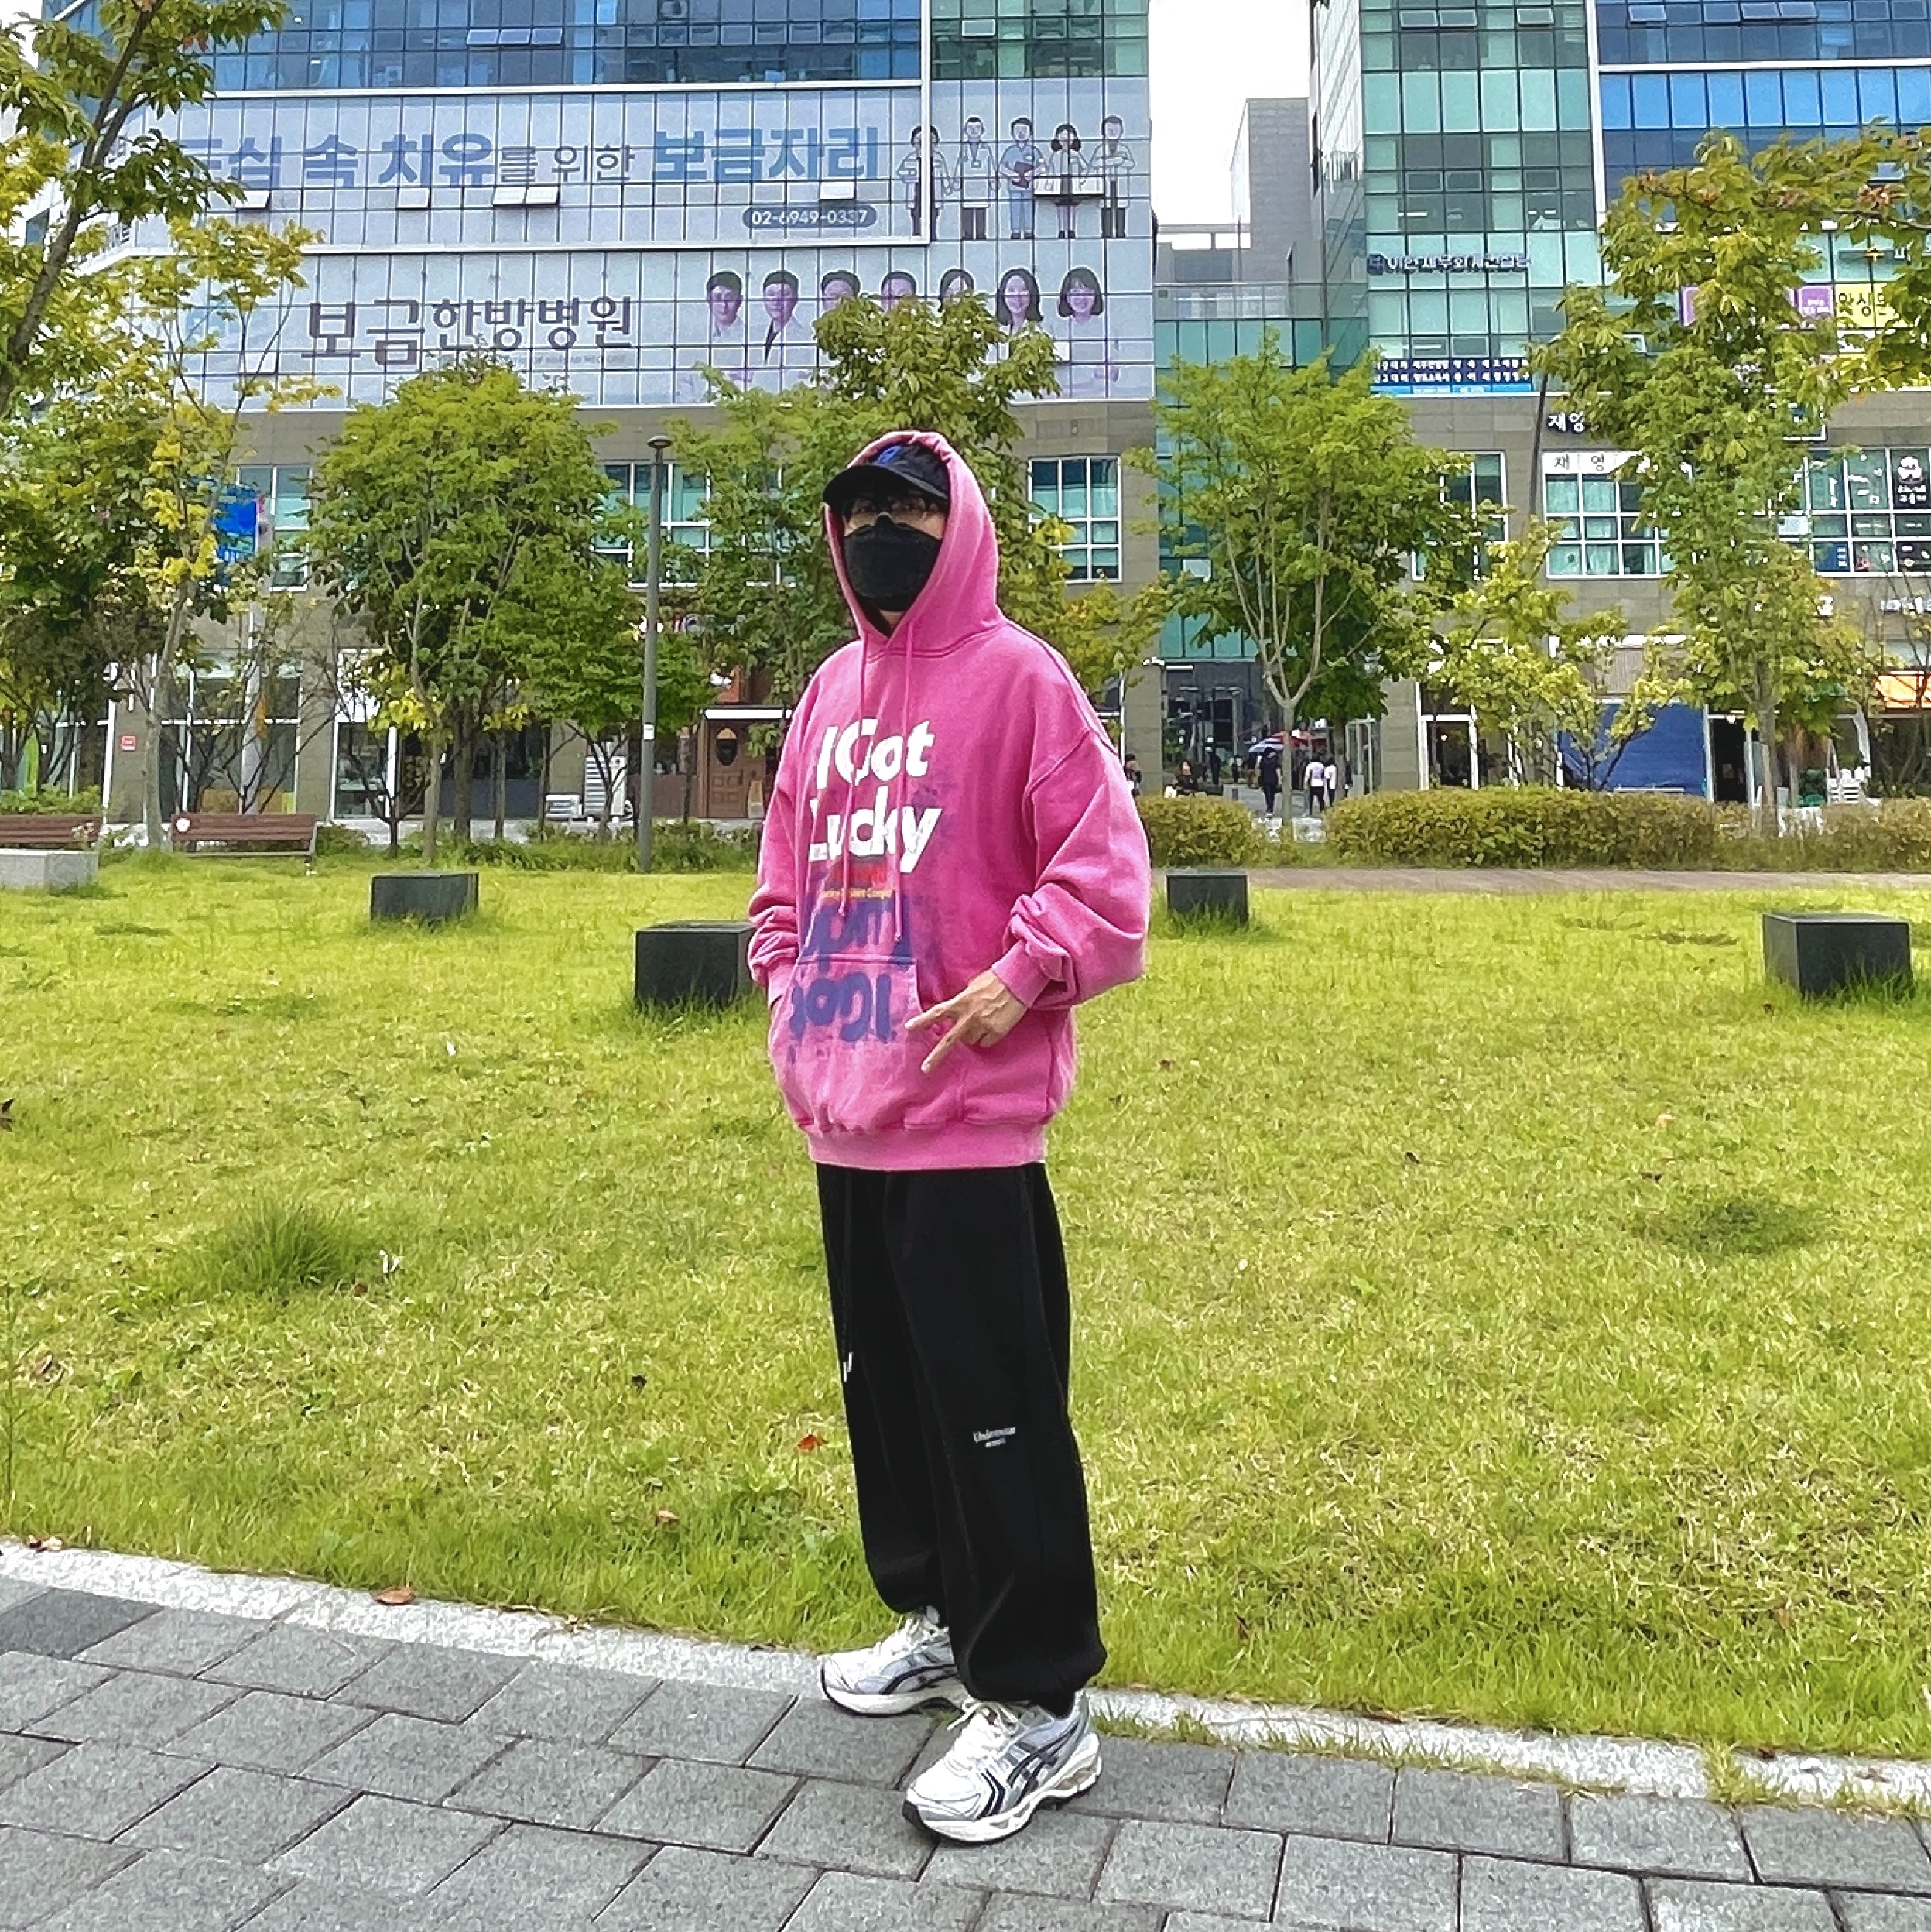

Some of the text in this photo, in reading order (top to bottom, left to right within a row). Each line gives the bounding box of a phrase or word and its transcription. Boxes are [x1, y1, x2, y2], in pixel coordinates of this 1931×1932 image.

[304, 134, 358, 187] 속
[378, 133, 539, 187] 치유를
[551, 142, 635, 182] 위한
[652, 126, 878, 180] 보금자리
[752, 209, 868, 225] 02-6949-0337
[300, 296, 632, 365] 보금한방병원
